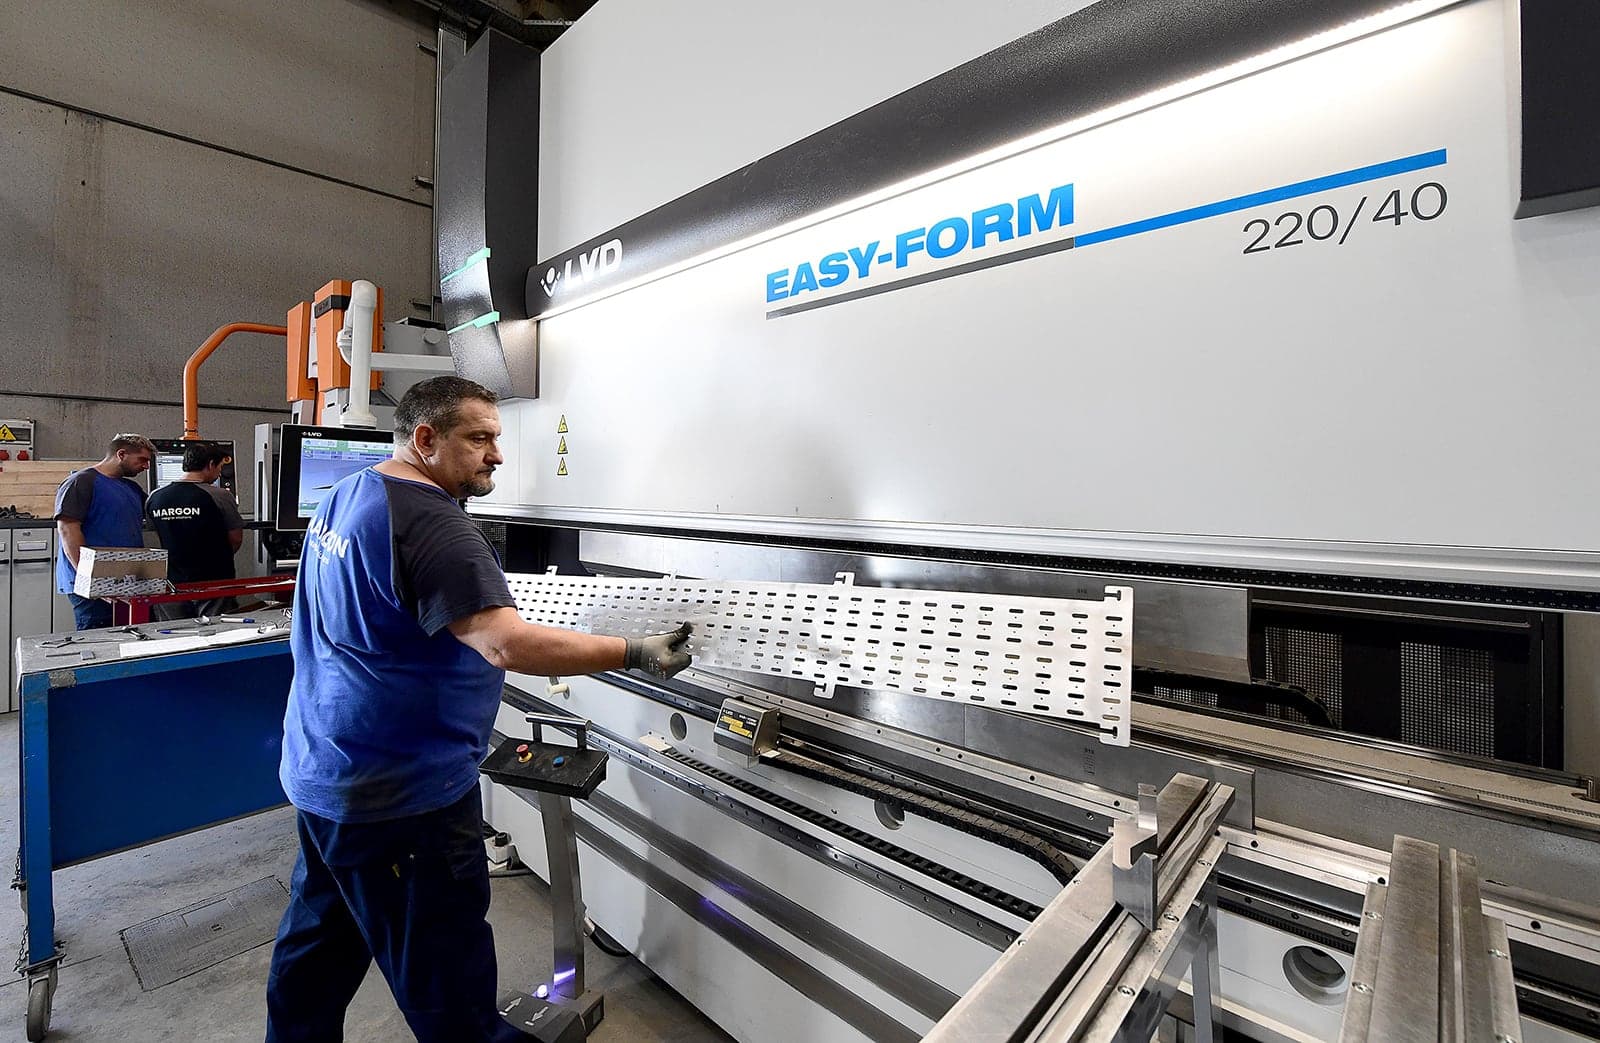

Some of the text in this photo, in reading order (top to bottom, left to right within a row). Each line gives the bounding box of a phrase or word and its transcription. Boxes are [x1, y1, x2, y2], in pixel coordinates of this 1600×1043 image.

[766, 183, 1074, 303] EASY-FORM
[1243, 182, 1448, 255] 220/40
[564, 238, 623, 288] LVD
[152, 507, 200, 518] MARGON
